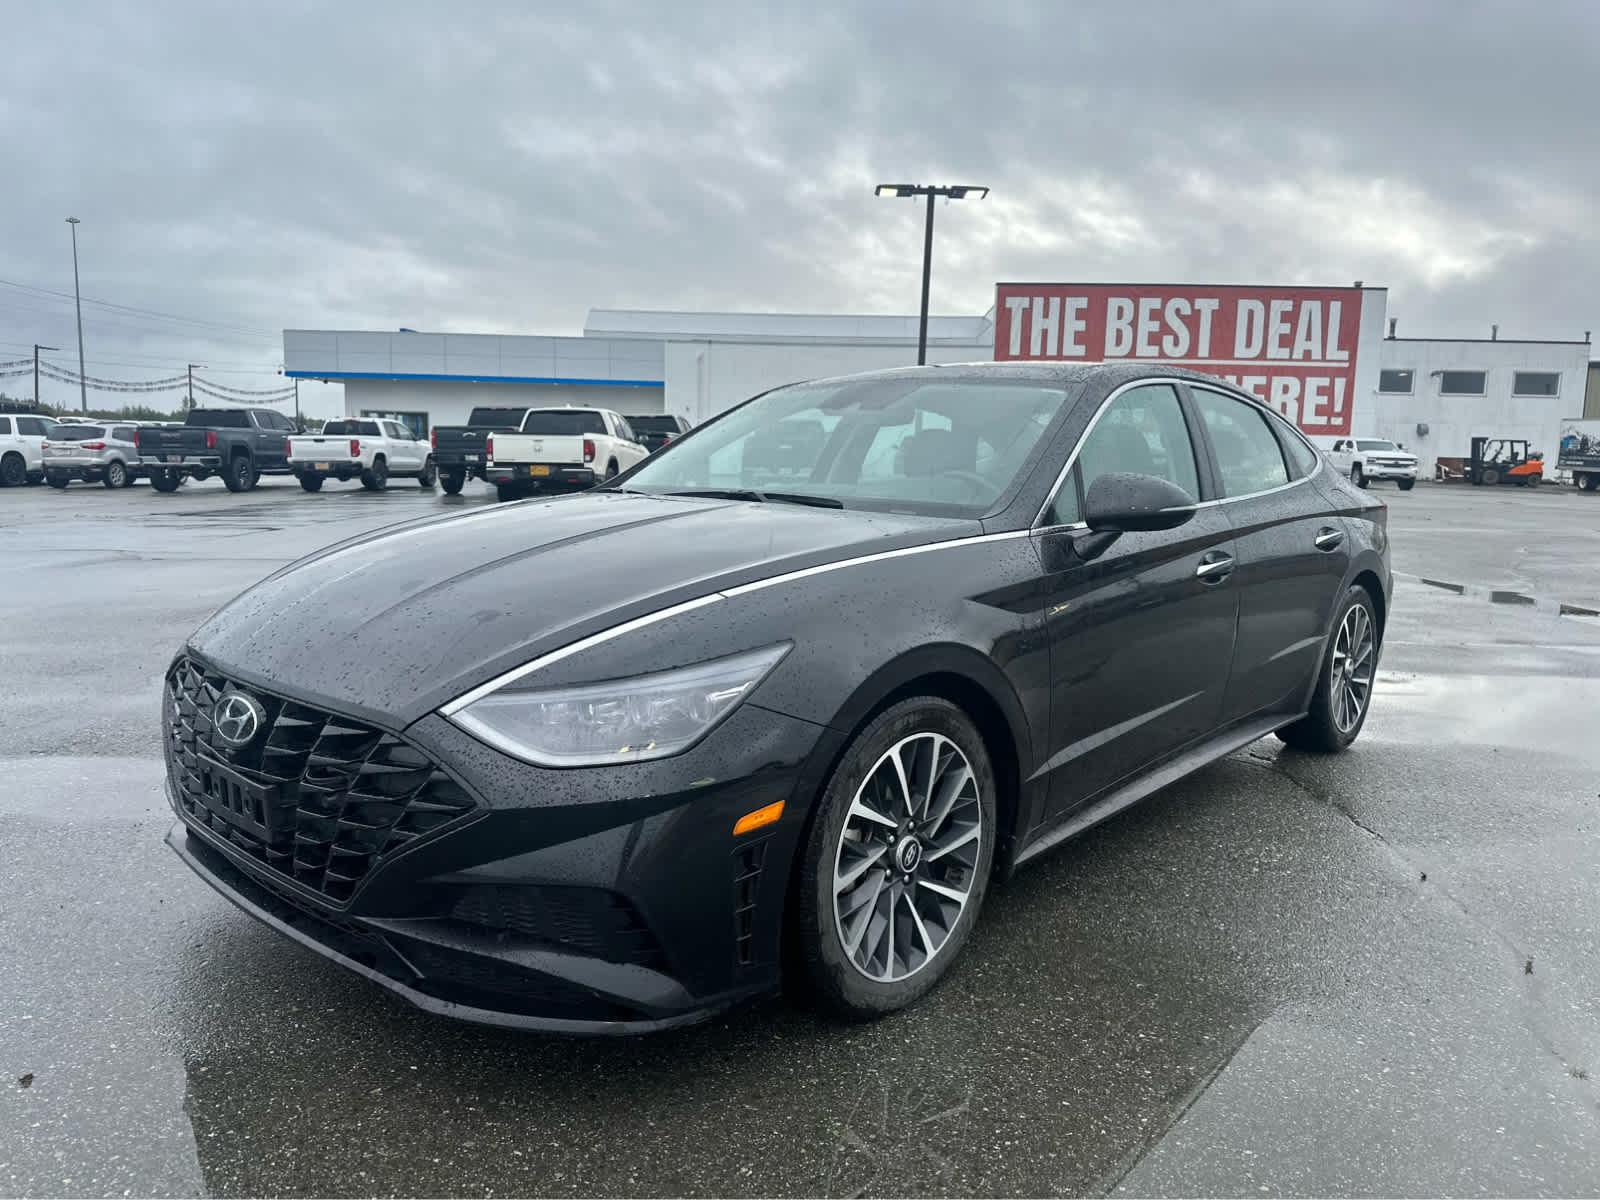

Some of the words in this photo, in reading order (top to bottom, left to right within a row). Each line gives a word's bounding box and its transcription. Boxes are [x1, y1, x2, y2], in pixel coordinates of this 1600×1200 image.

[1005, 296, 1089, 357] THE
[1103, 297, 1220, 358] BEST
[1233, 299, 1350, 361] DEAL
[1211, 374, 1347, 426] RE!
